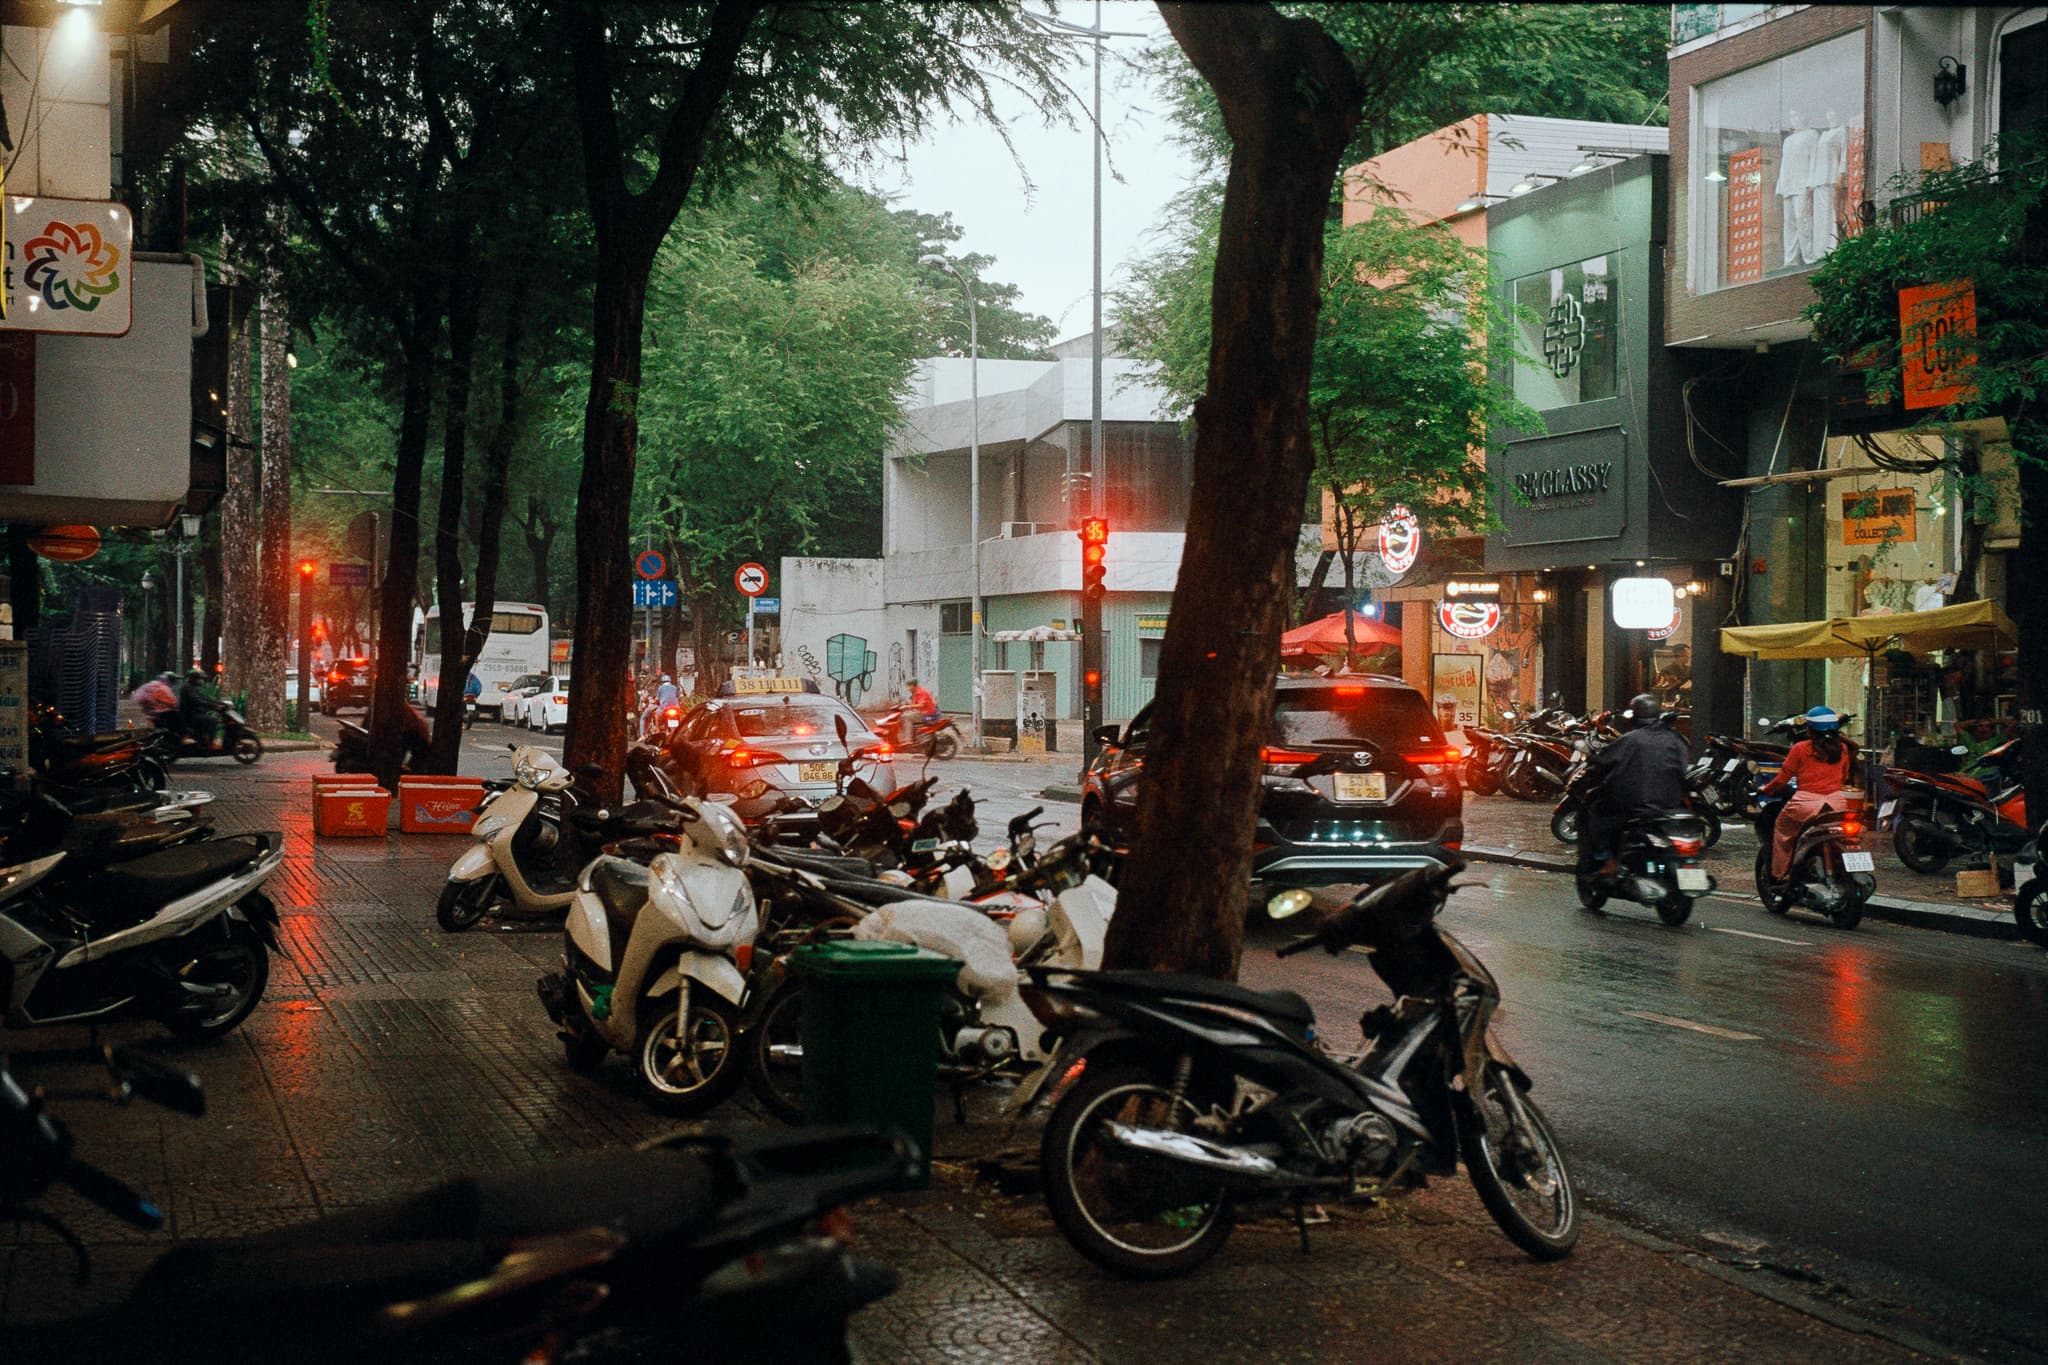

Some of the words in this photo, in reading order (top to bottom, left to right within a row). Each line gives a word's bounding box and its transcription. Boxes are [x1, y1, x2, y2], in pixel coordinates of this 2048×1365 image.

[1450, 623, 1490, 636] COFFEE
[740, 680, 755, 690] 38
[1459, 712, 1473, 722] 35
